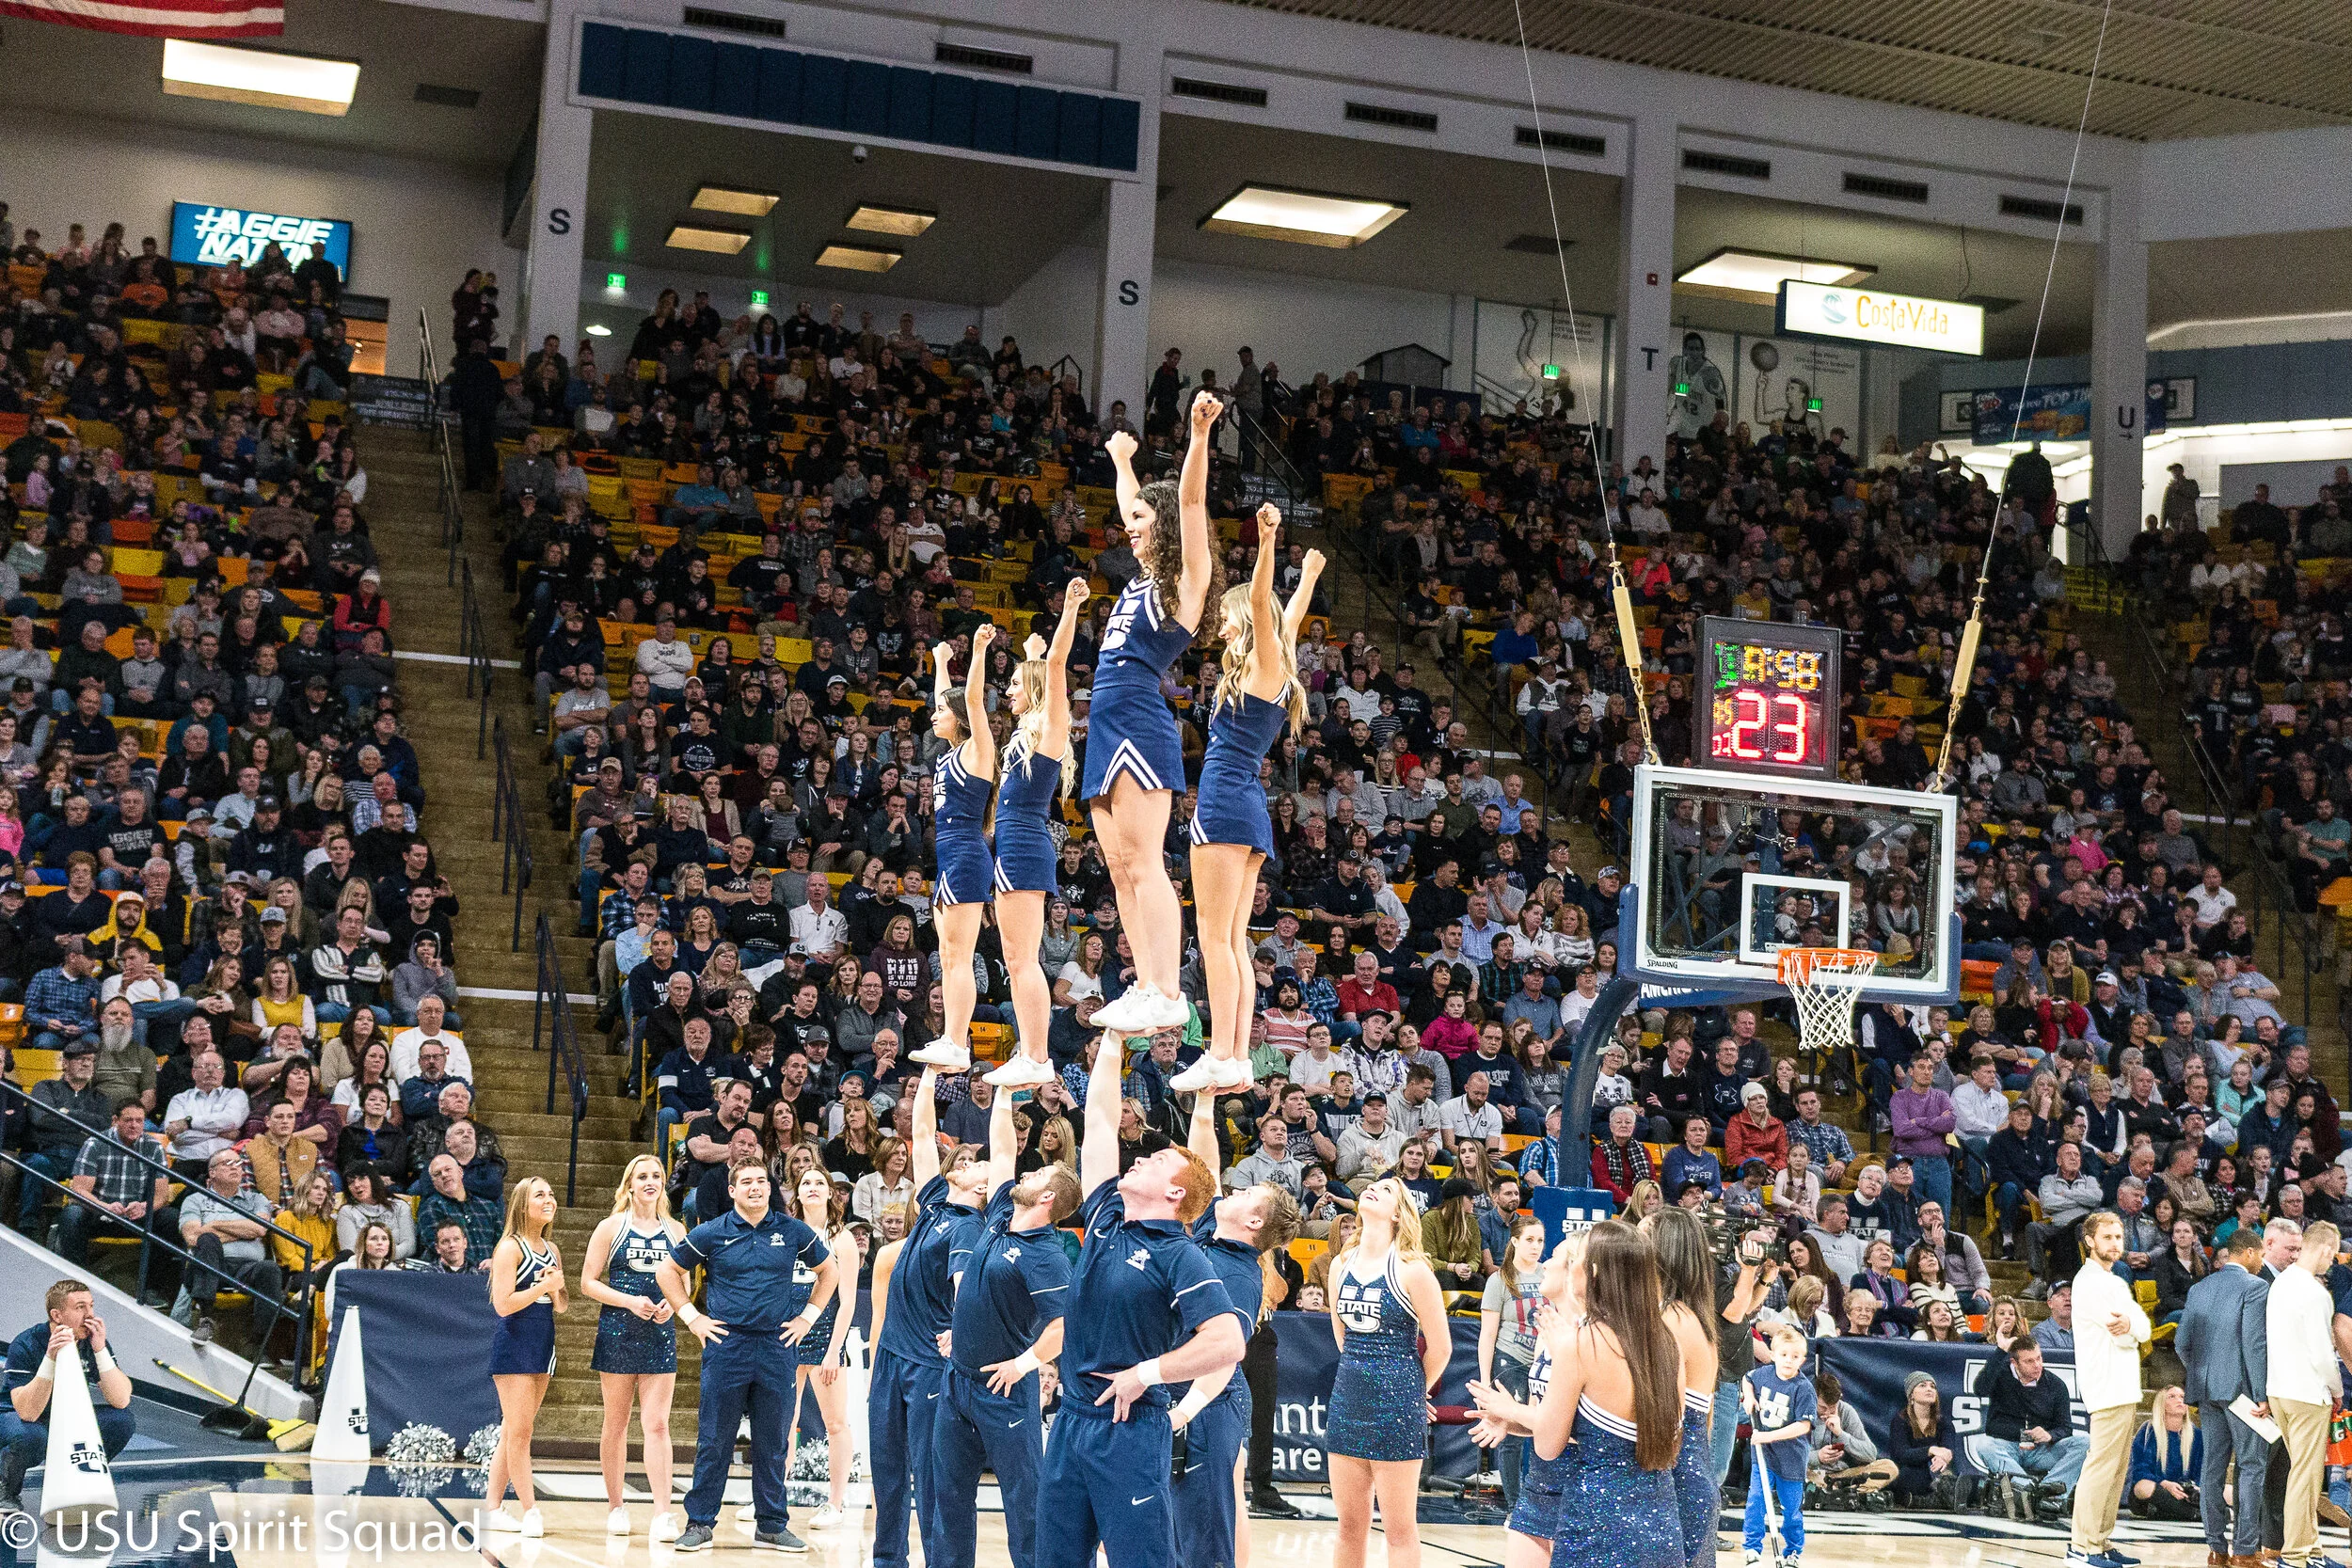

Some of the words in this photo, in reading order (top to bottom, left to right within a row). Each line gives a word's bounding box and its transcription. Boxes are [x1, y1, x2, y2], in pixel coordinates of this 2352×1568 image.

[194, 207, 334, 244] #AGGIE
[548, 208, 571, 235] S
[1119, 280, 1138, 306] S
[1641, 346, 1659, 371] T
[2119, 405, 2134, 429] U
[1743, 645, 1819, 692] 9:58
[1733, 689, 1808, 764] 23
[1647, 958, 1678, 969] SPALDING
[1337, 1300, 1382, 1319] STATE
[2335, 1429, 2344, 1442] G
